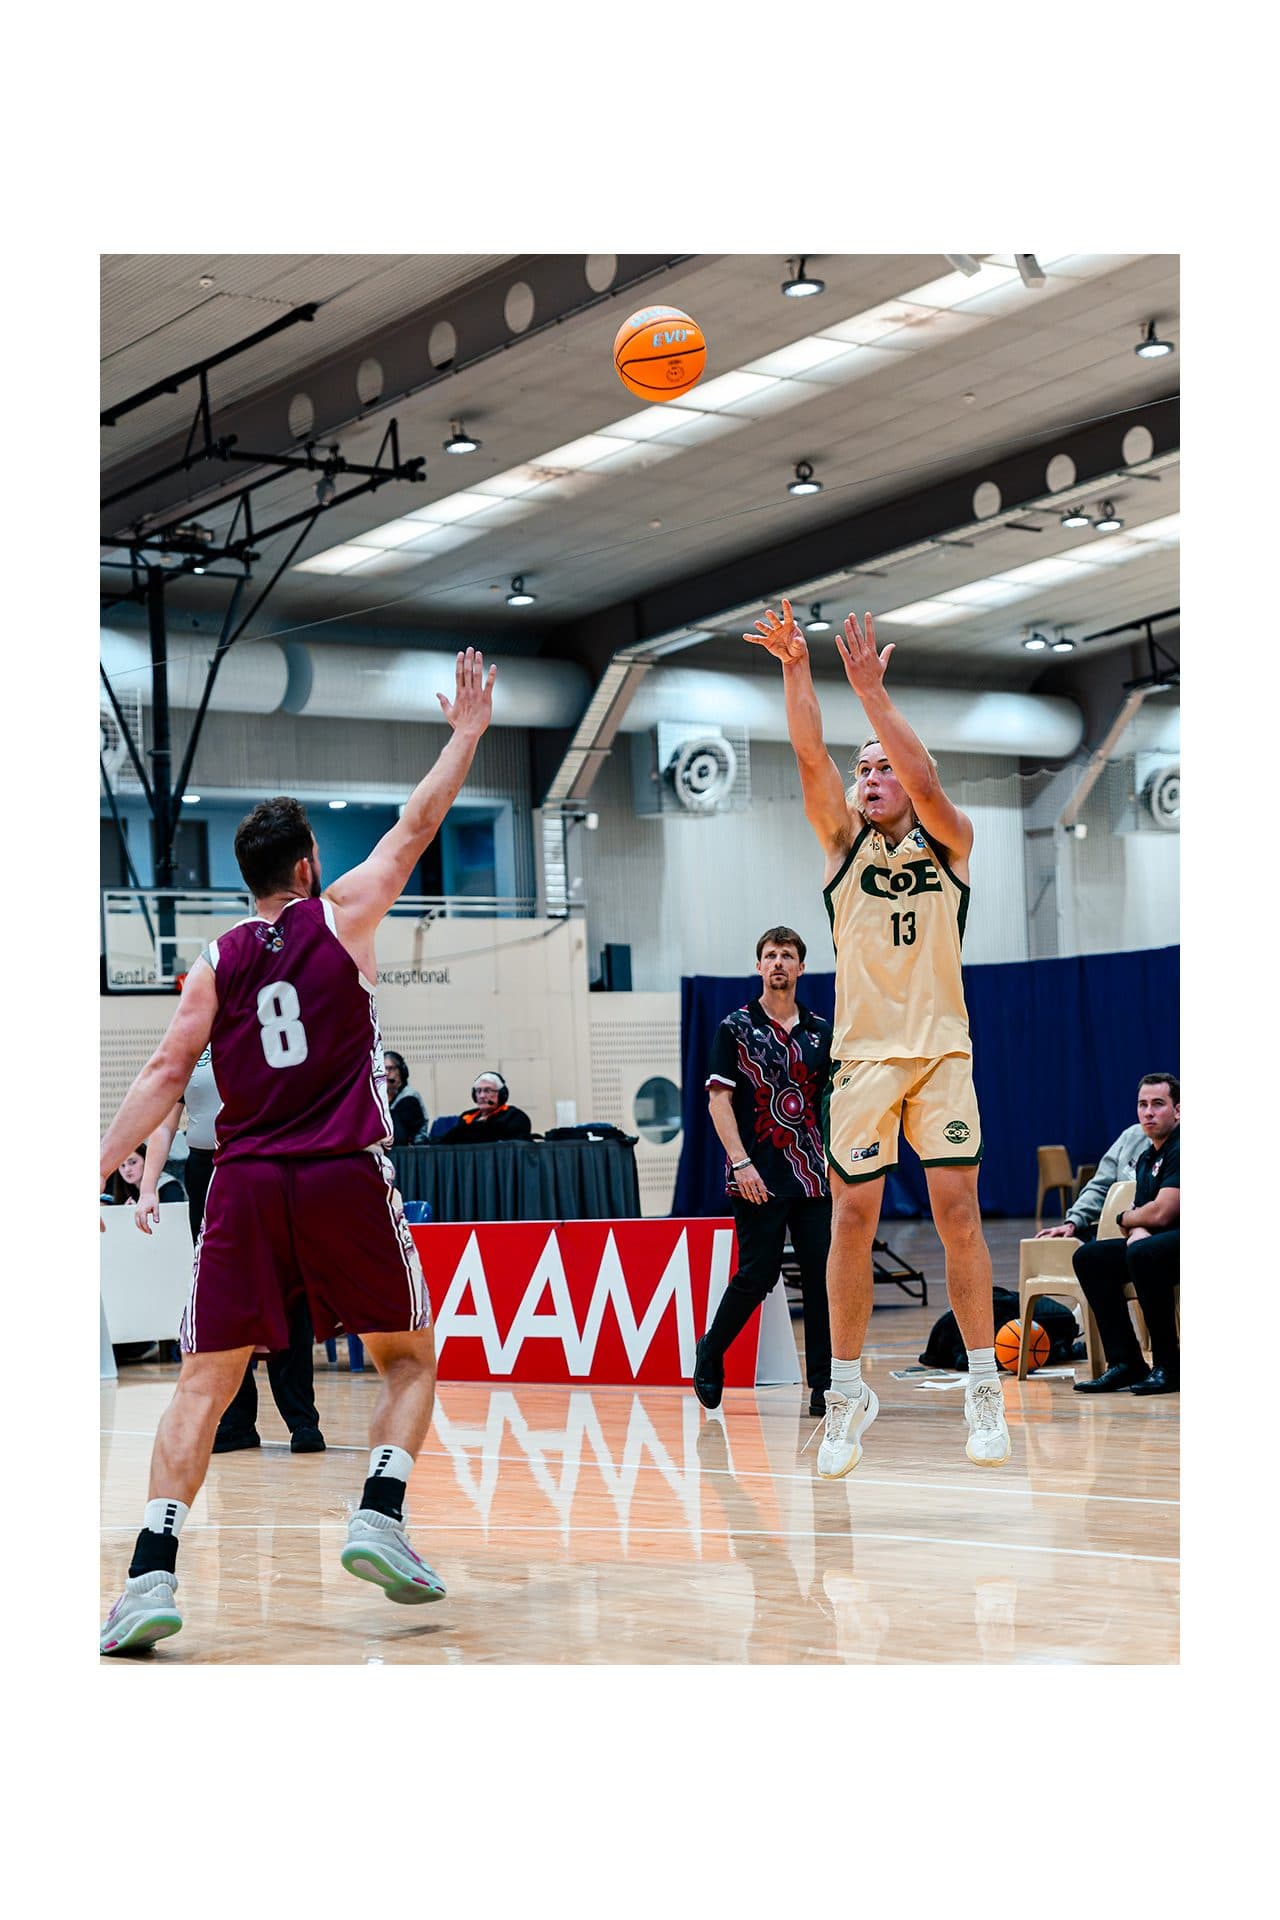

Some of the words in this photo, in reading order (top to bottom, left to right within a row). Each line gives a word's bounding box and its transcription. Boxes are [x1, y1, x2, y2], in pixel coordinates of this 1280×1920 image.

[890, 911, 917, 947] 13
[256, 980, 309, 1069] 8
[434, 1226, 734, 1380] AAMI
